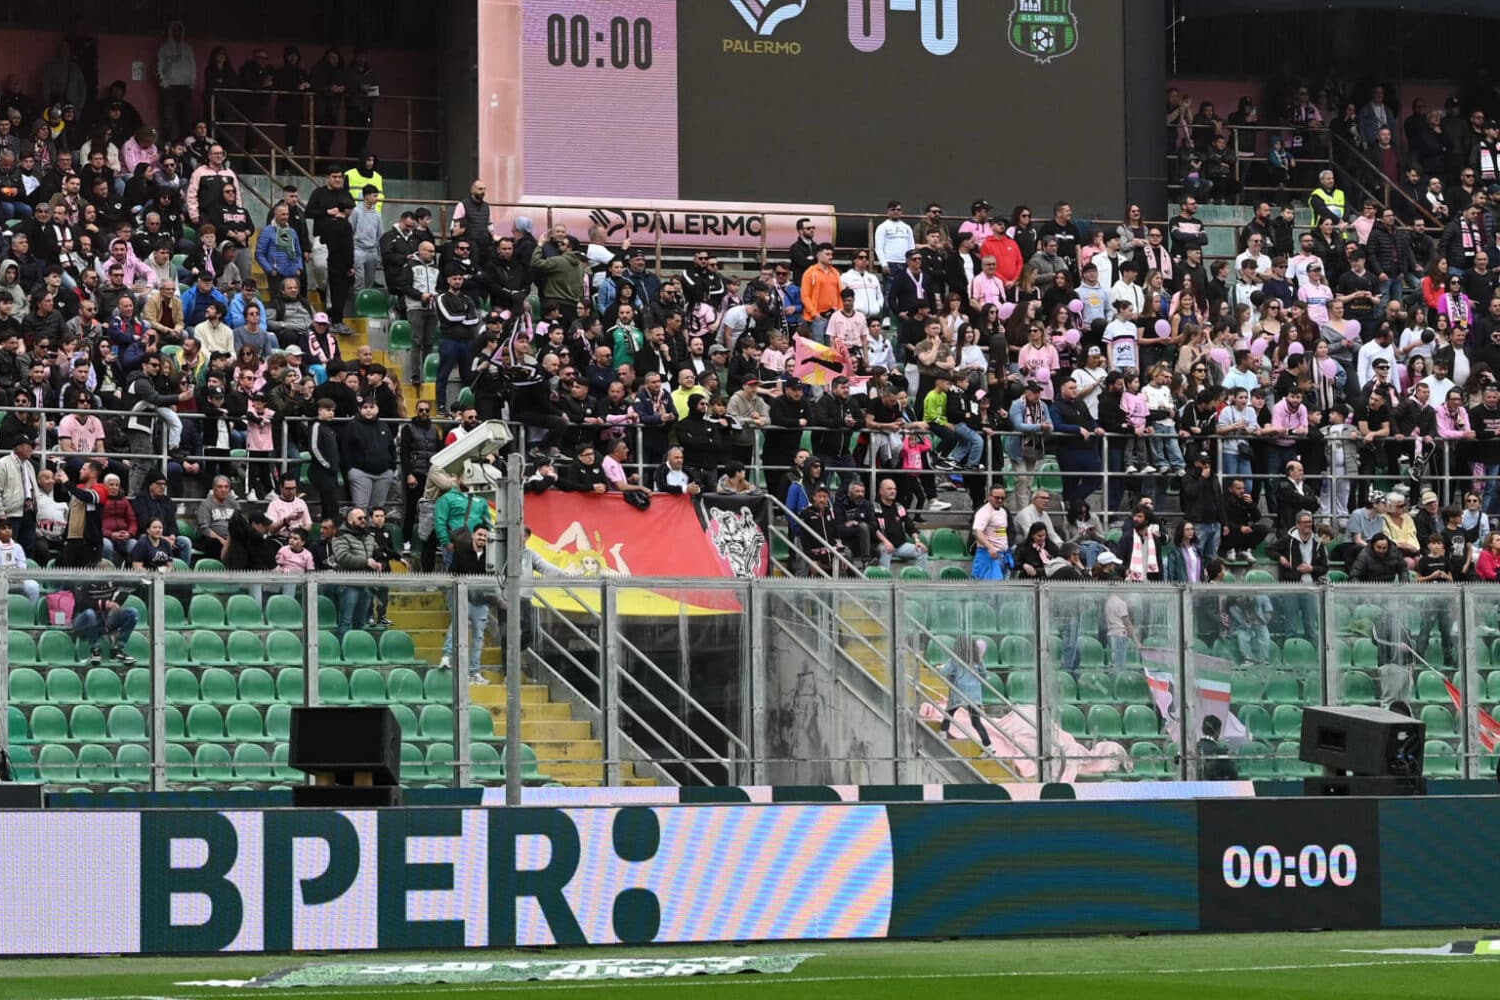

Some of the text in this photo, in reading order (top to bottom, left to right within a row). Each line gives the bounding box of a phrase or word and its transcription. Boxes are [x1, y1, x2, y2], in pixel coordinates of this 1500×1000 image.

[547, 13, 653, 70] 00:00
[723, 39, 802, 55] PALERMO
[631, 212, 763, 237] PALERMO
[1222, 844, 1357, 888] 00:00
